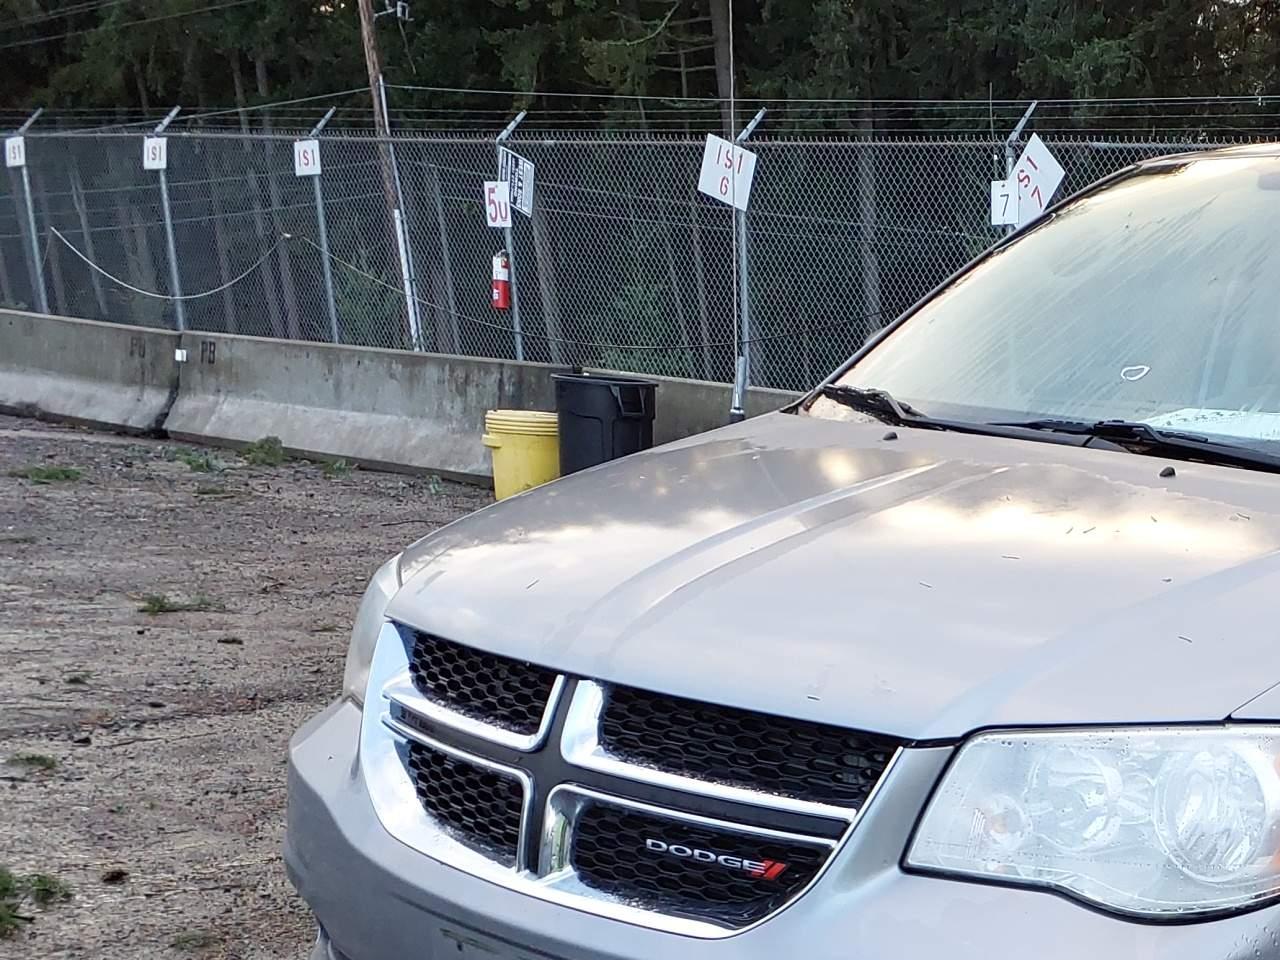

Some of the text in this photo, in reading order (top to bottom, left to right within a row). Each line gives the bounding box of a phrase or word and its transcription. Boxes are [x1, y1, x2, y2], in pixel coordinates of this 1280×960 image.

[999, 193, 1010, 217] 7
[1030, 185, 1043, 209] 7
[645, 838, 767, 875] DODGE
